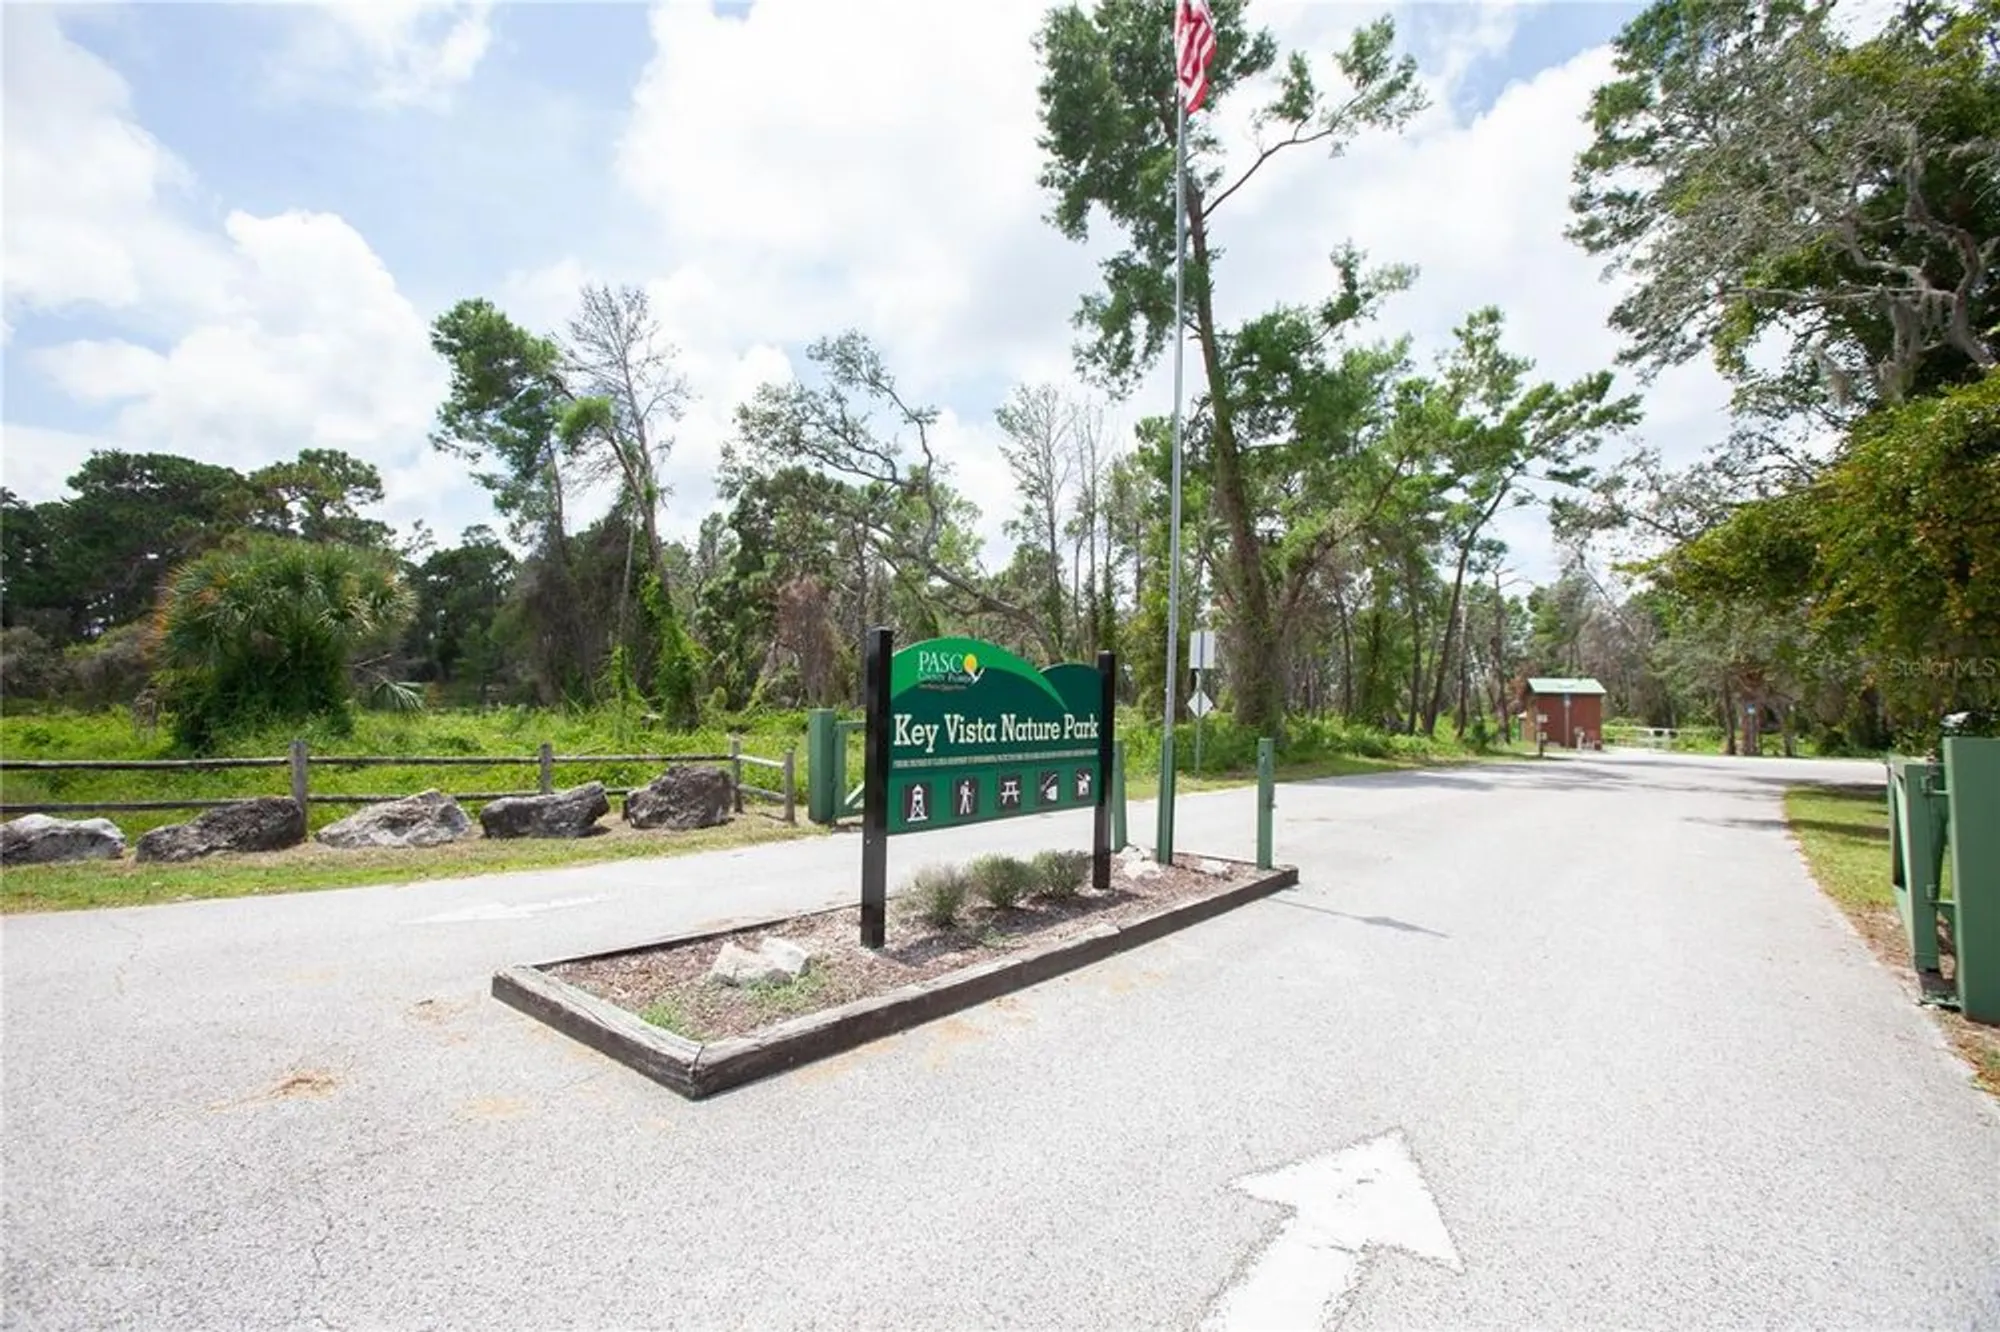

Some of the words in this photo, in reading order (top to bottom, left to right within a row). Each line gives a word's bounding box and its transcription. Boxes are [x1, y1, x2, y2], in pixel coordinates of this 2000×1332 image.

[893, 713, 940, 753] Key
[944, 713, 996, 744] Vista
[1000, 713, 1060, 741] Nature
[1063, 713, 1099, 740] Park
